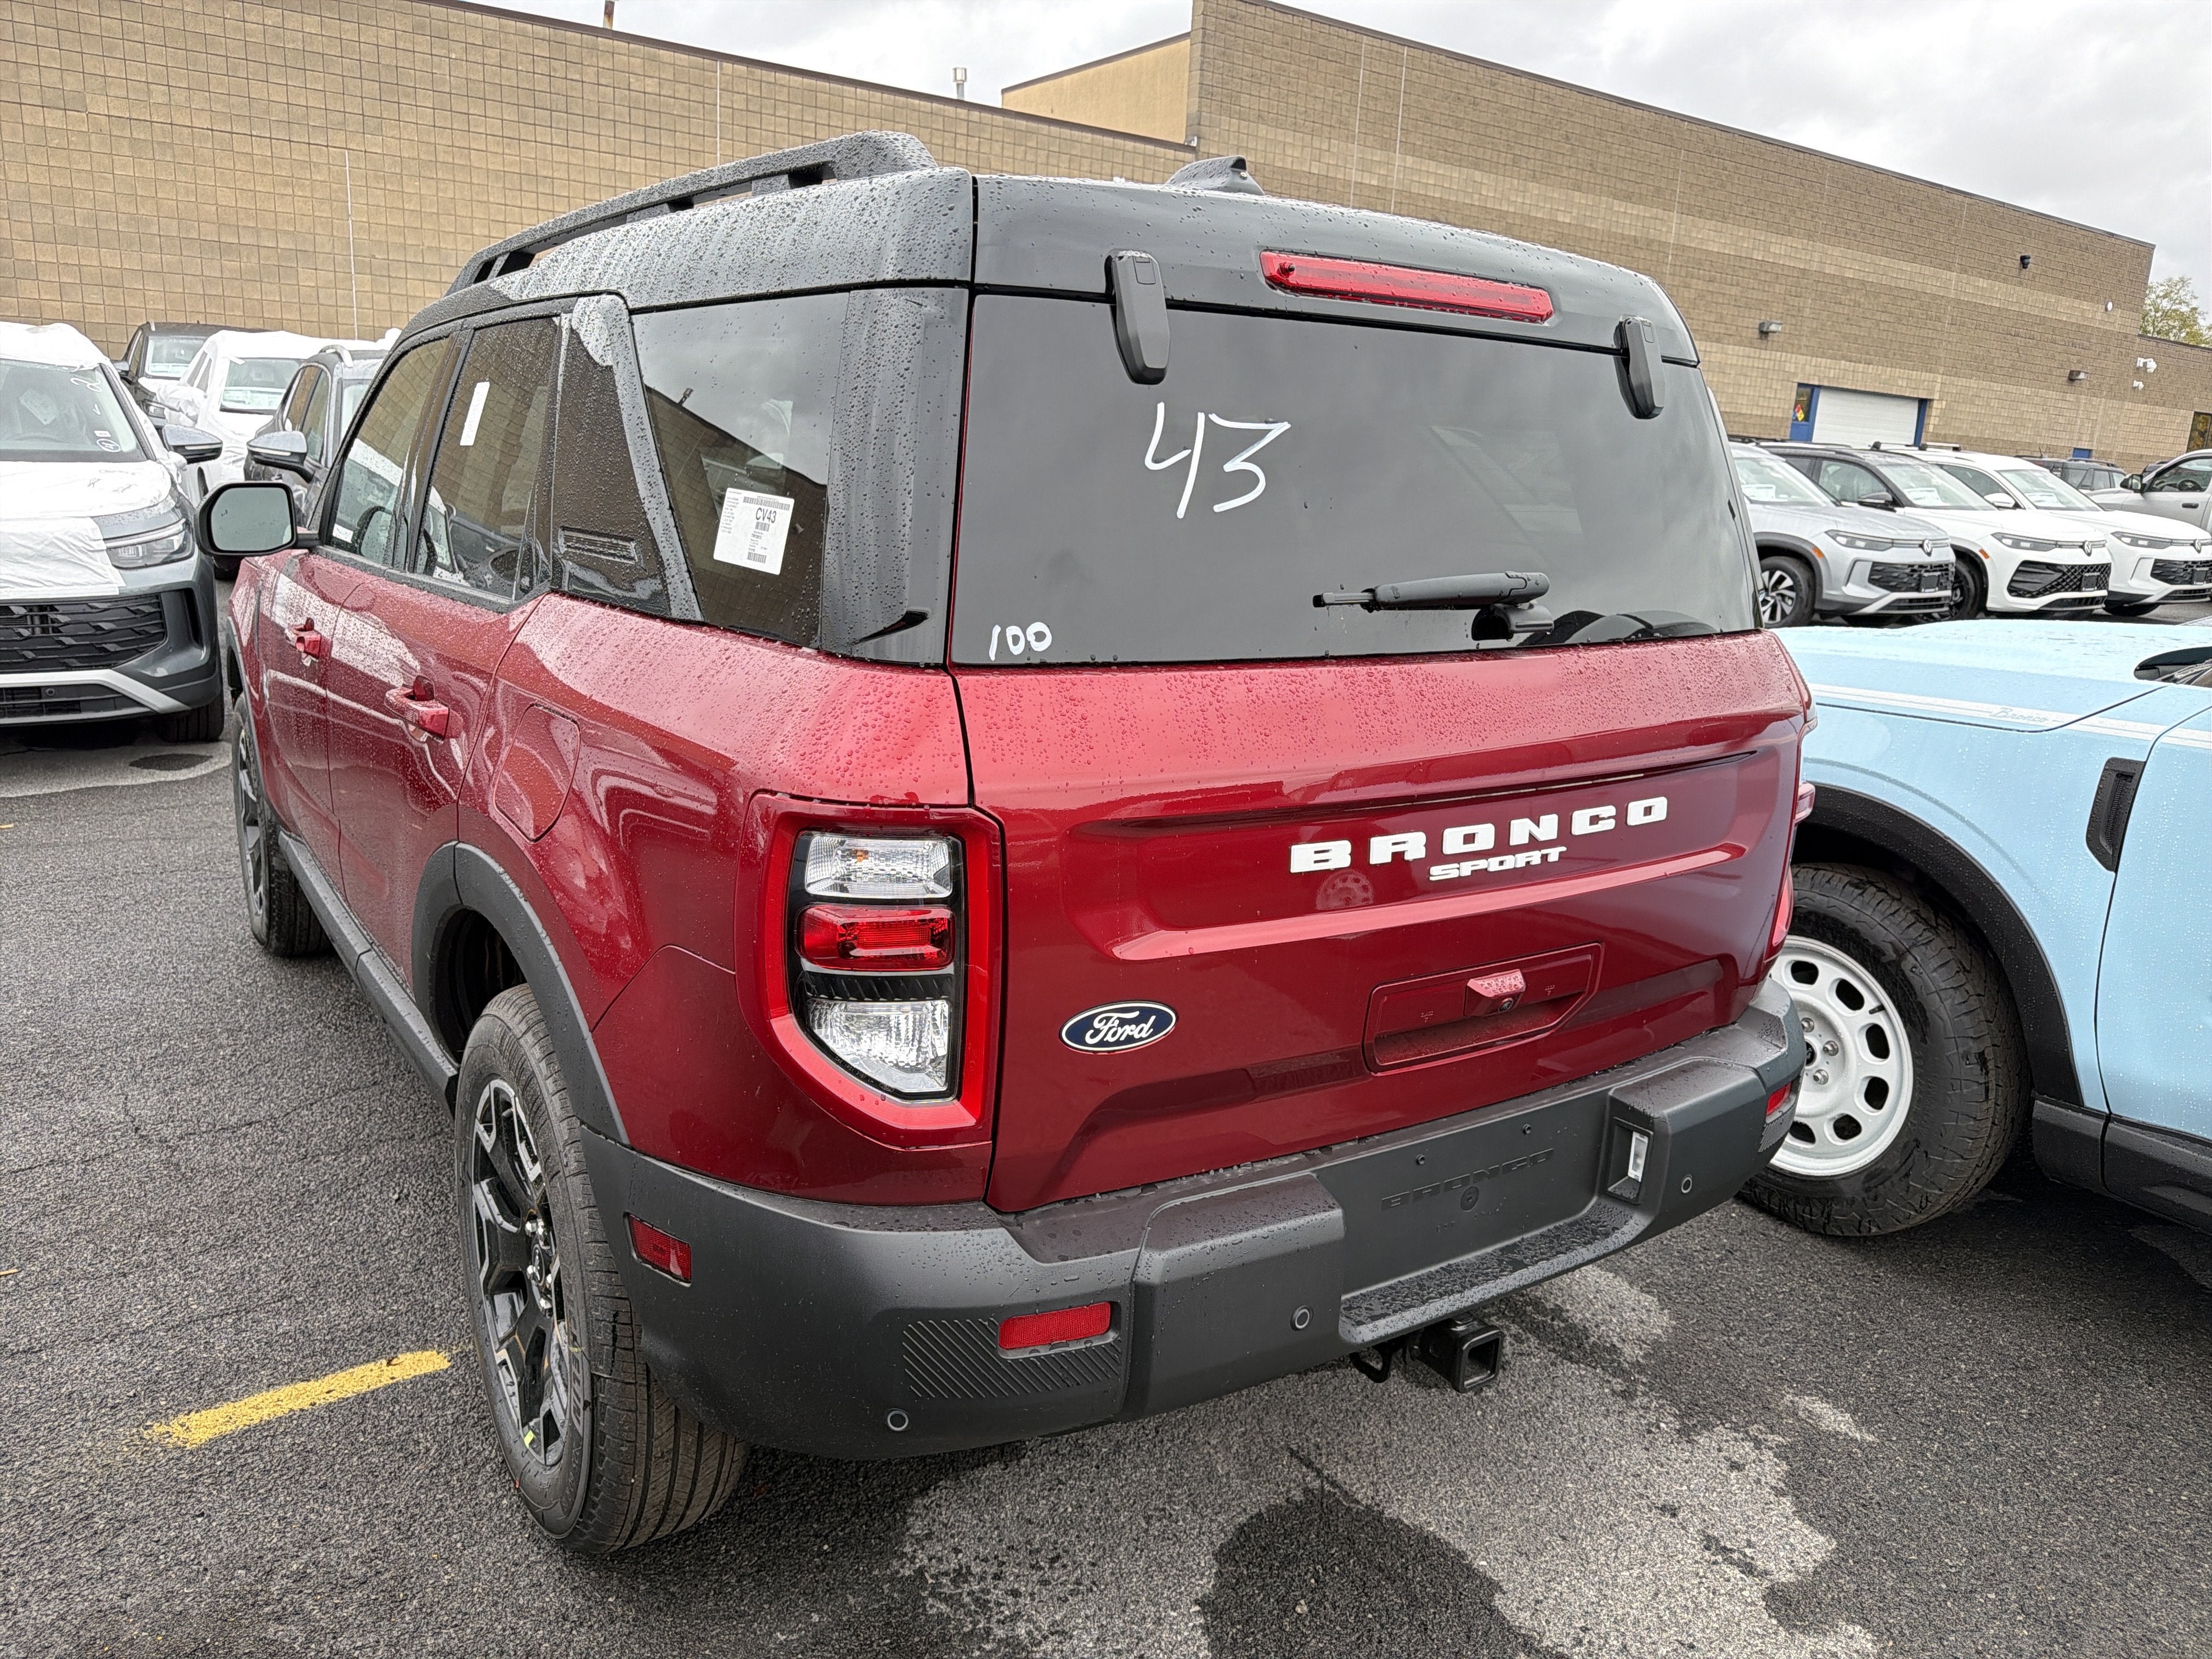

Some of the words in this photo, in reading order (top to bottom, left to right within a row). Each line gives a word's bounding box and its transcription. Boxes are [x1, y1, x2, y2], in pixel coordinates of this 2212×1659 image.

[1144, 402, 1291, 518] 43
[755, 507, 777, 523] CV43
[989, 622, 1052, 661] 100
[1990, 707, 2049, 723] Bronco
[1290, 797, 1667, 873] BRONCO
[1429, 846, 1567, 881] SPORT
[1085, 1011, 1156, 1045] Ford
[1381, 1148, 1554, 1211] BRONCO
